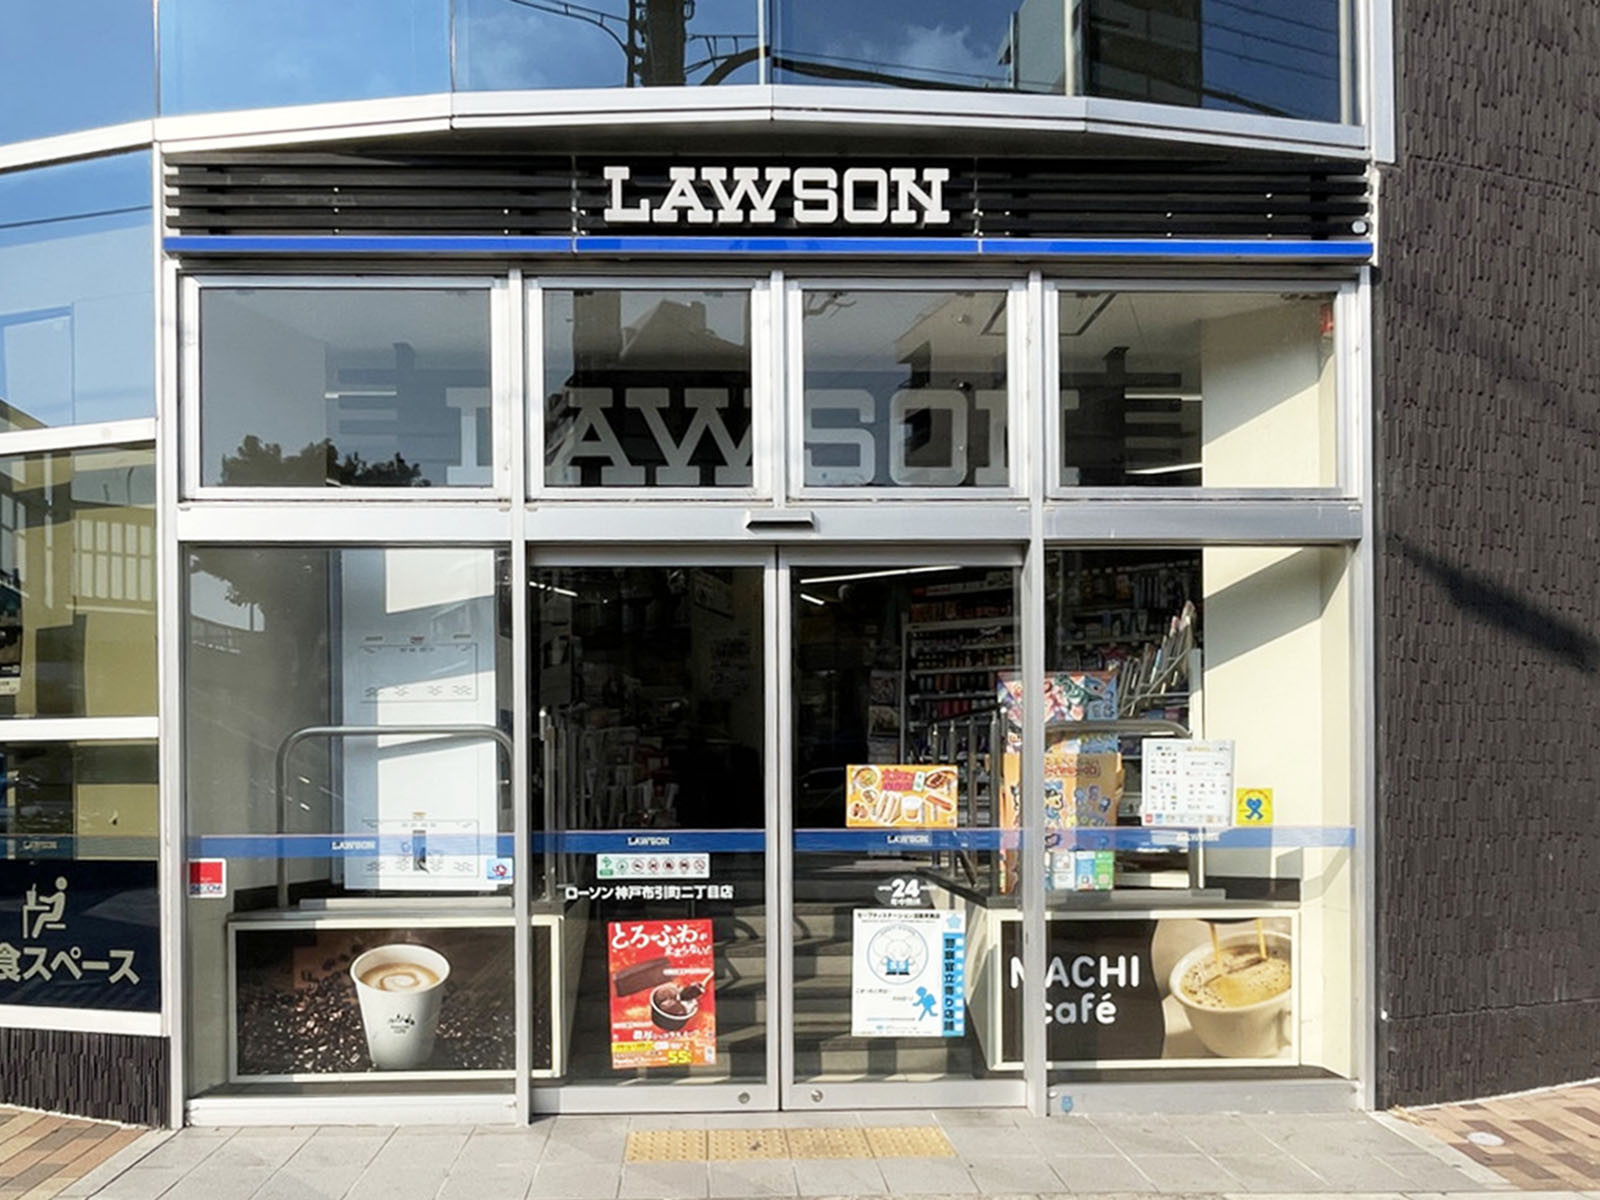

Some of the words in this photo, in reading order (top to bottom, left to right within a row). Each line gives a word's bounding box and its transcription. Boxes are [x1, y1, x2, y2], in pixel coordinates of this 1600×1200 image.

[604, 166, 950, 225] LAWSON
[628, 837, 670, 846] LAWSON
[887, 835, 929, 844] LAWSON
[332, 841, 376, 850] LAWSON
[892, 878, 920, 898] 24
